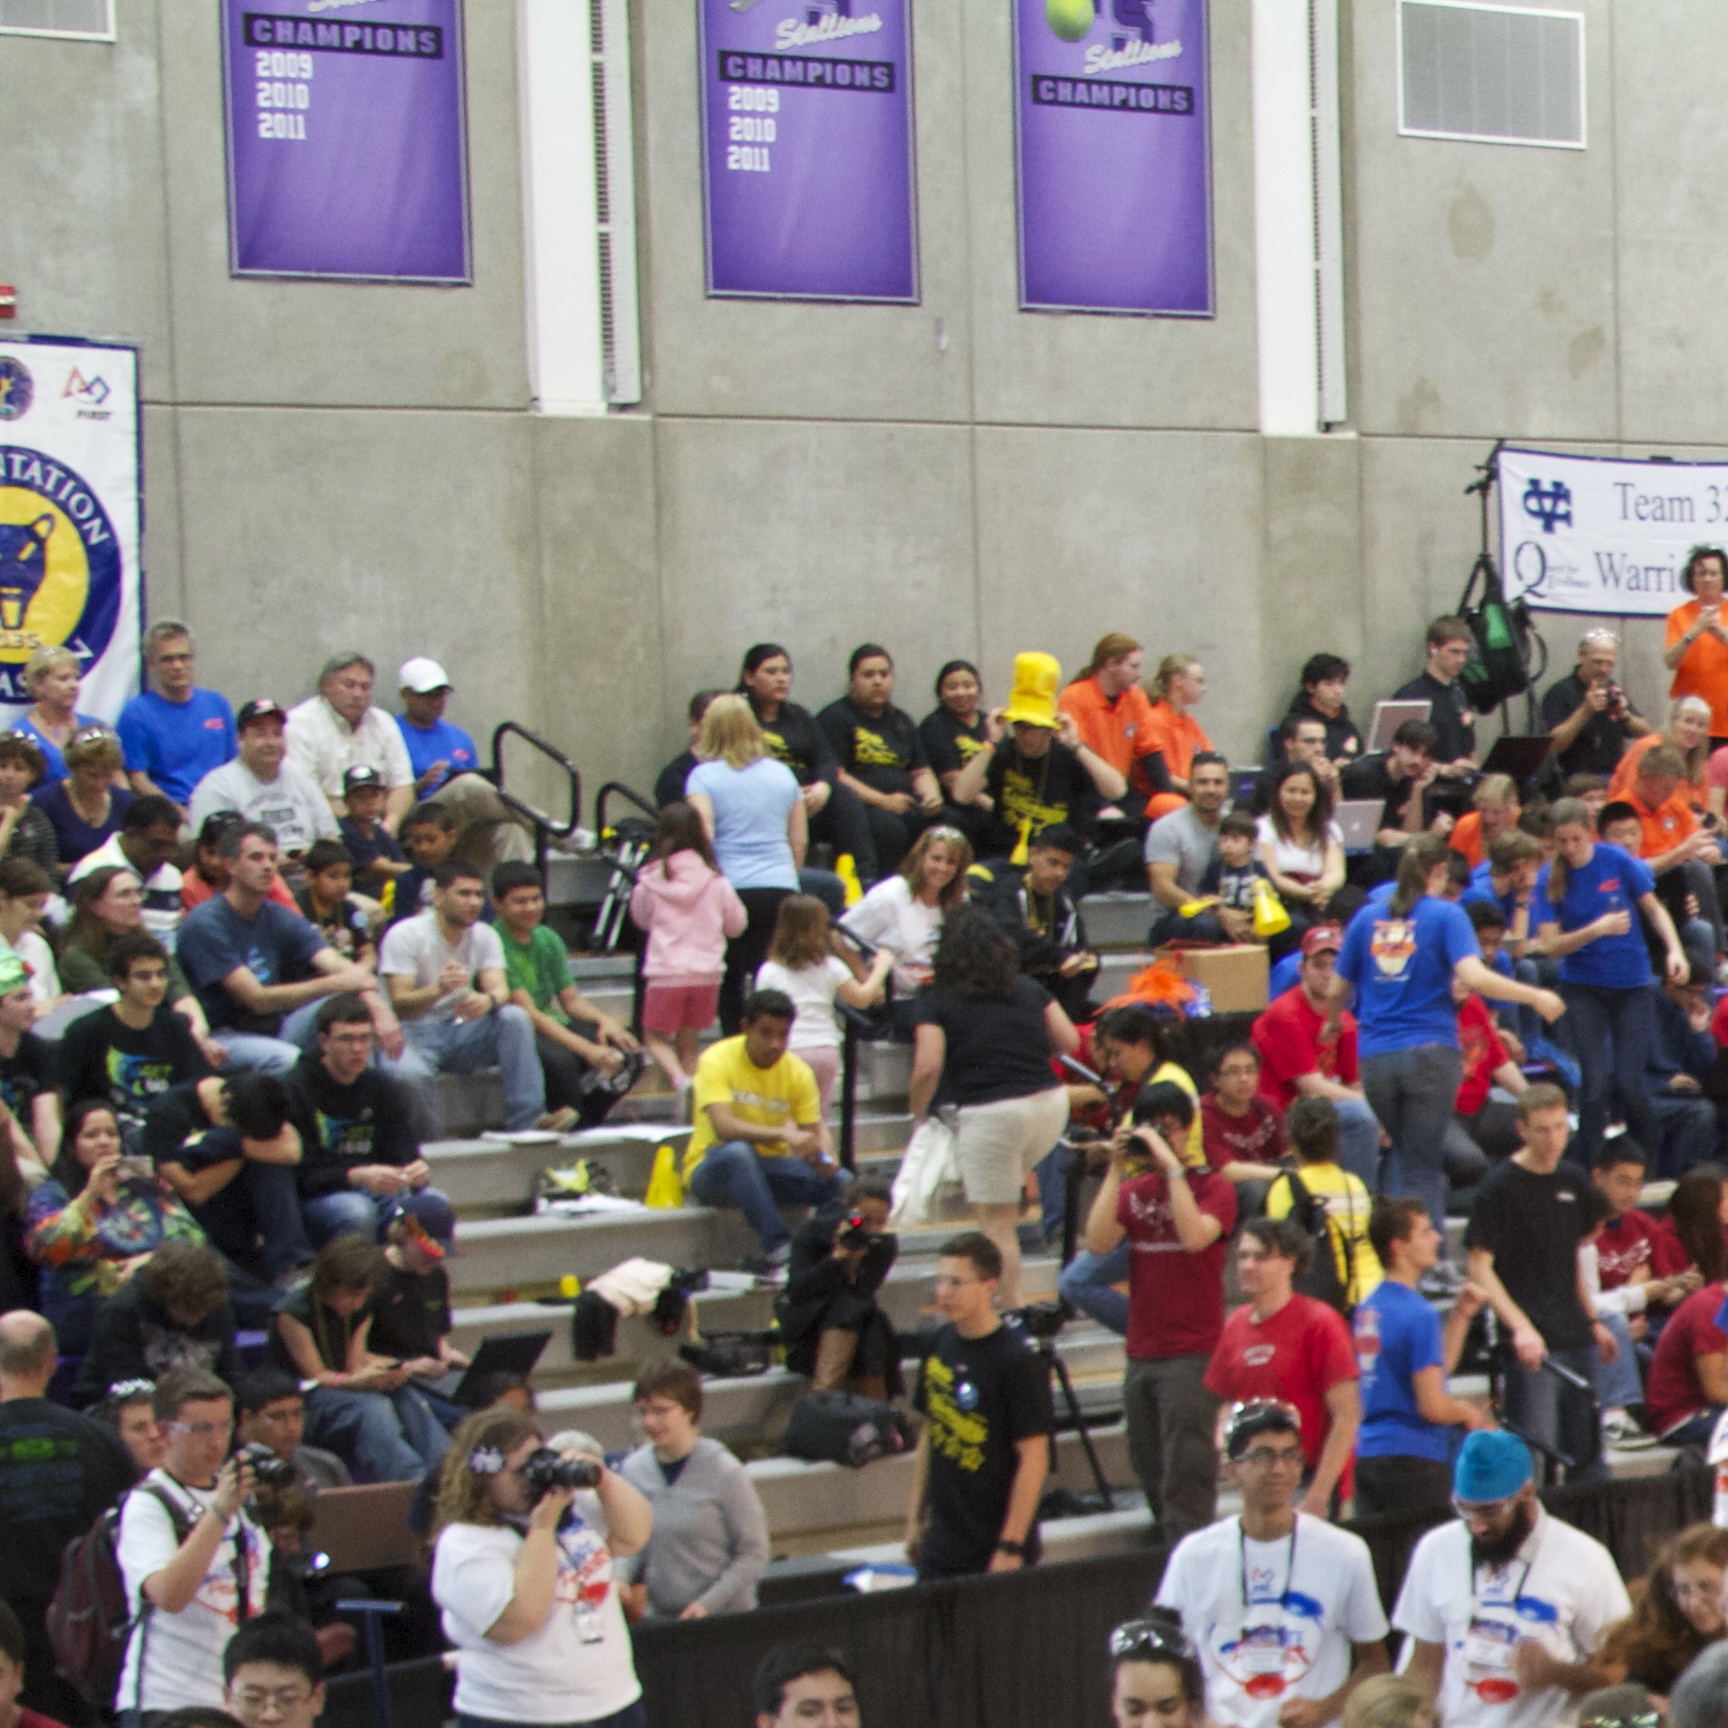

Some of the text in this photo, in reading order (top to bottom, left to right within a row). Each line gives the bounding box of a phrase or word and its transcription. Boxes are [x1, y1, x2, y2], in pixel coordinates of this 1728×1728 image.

[253, 20, 437, 54] CHAMPIONS
[256, 52, 313, 79] 2009
[727, 55, 891, 88] CHAMPIONS
[256, 82, 309, 109] 2010
[728, 86, 780, 114] 2009
[1039, 80, 1189, 112] CHAMPIONS
[258, 112, 307, 140] 2011
[728, 116, 777, 143] 2010
[727, 145, 771, 172] 2011
[1613, 482, 1696, 522] Team
